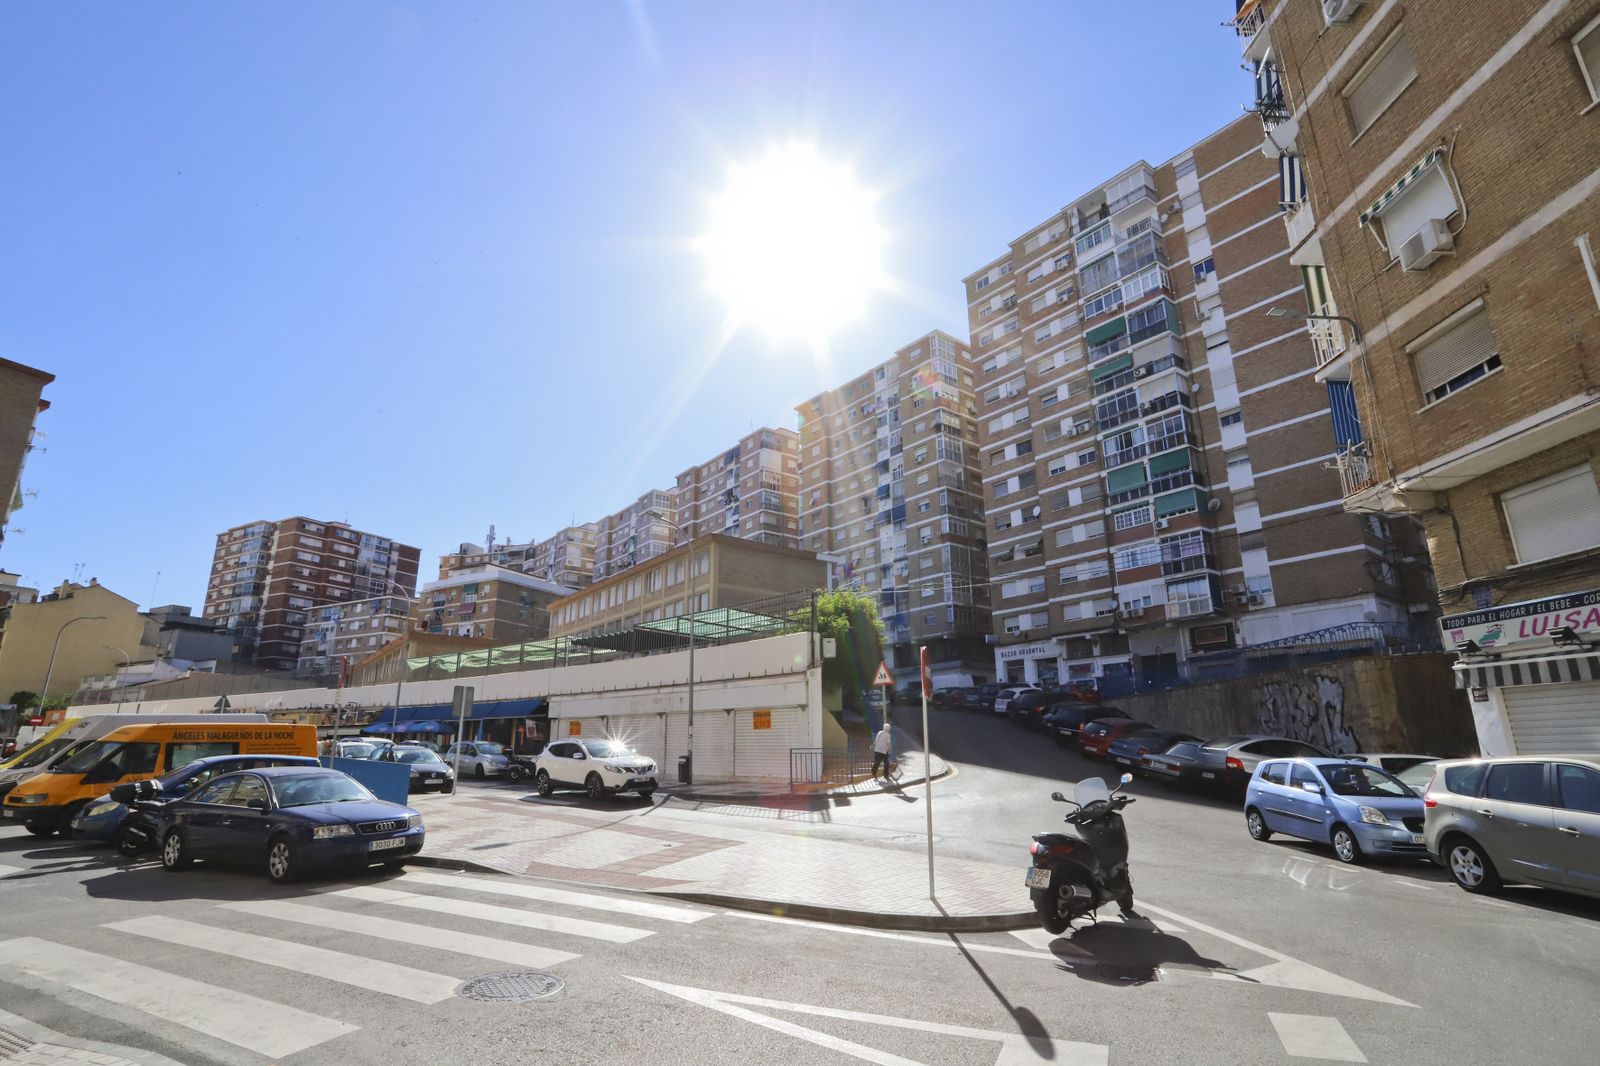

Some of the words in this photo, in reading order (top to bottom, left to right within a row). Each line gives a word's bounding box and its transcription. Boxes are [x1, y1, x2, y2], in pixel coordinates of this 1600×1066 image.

[1447, 618, 1465, 628] TODO
[1467, 614, 1485, 625] PARA
[1488, 612, 1496, 621] EL
[1500, 608, 1526, 619] HOGAR
[1529, 605, 1534, 614] Y
[1537, 604, 1546, 613] EL
[1519, 607, 1600, 638] LUISA
[1001, 650, 1017, 658] BAZAR
[1019, 647, 1045, 656] ORIENTAL
[254, 731, 264, 740] DE
[264, 731, 273, 740] LA
[274, 731, 295, 740] NOCHE
